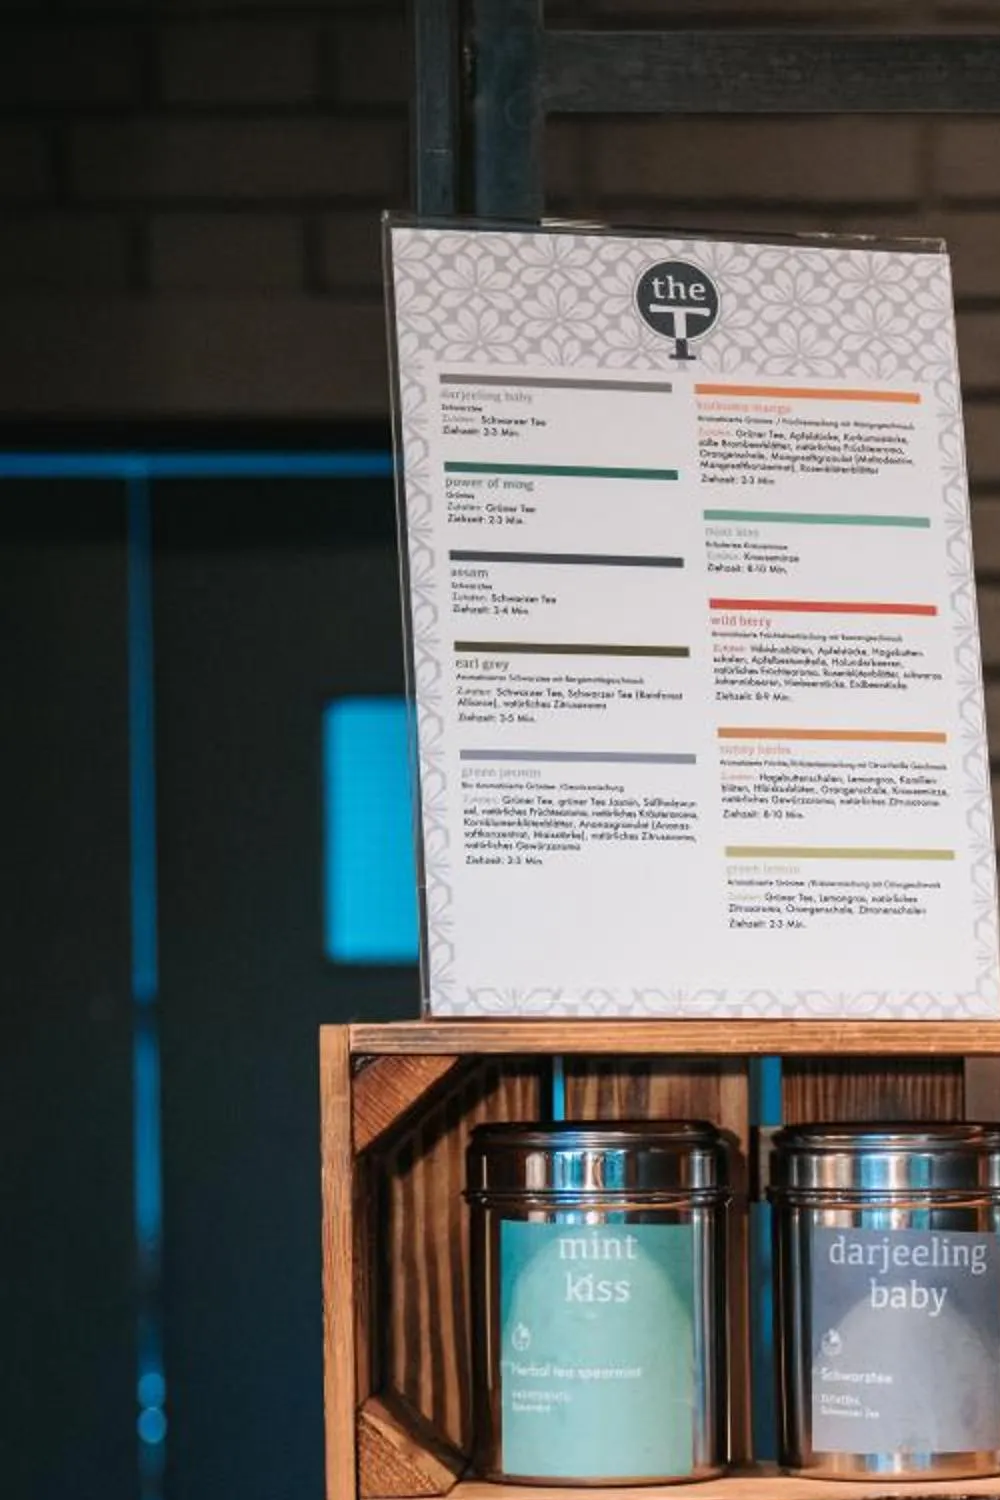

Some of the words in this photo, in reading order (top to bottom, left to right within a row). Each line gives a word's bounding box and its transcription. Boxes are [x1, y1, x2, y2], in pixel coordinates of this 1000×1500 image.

[652, 276, 706, 300] the
[531, 417, 546, 426] Tee
[445, 479, 482, 489] power
[488, 478, 499, 489] of
[521, 505, 536, 513] Tee
[451, 569, 488, 578] assam
[542, 595, 556, 604] Tee
[711, 616, 736, 626] wild
[739, 617, 771, 629] berry
[456, 659, 479, 669] earl
[483, 661, 509, 672] grey
[559, 1232, 638, 1260] mint
[829, 1236, 987, 1274] darjeeling
[566, 1272, 631, 1303] kiss
[871, 1278, 947, 1316] baby
